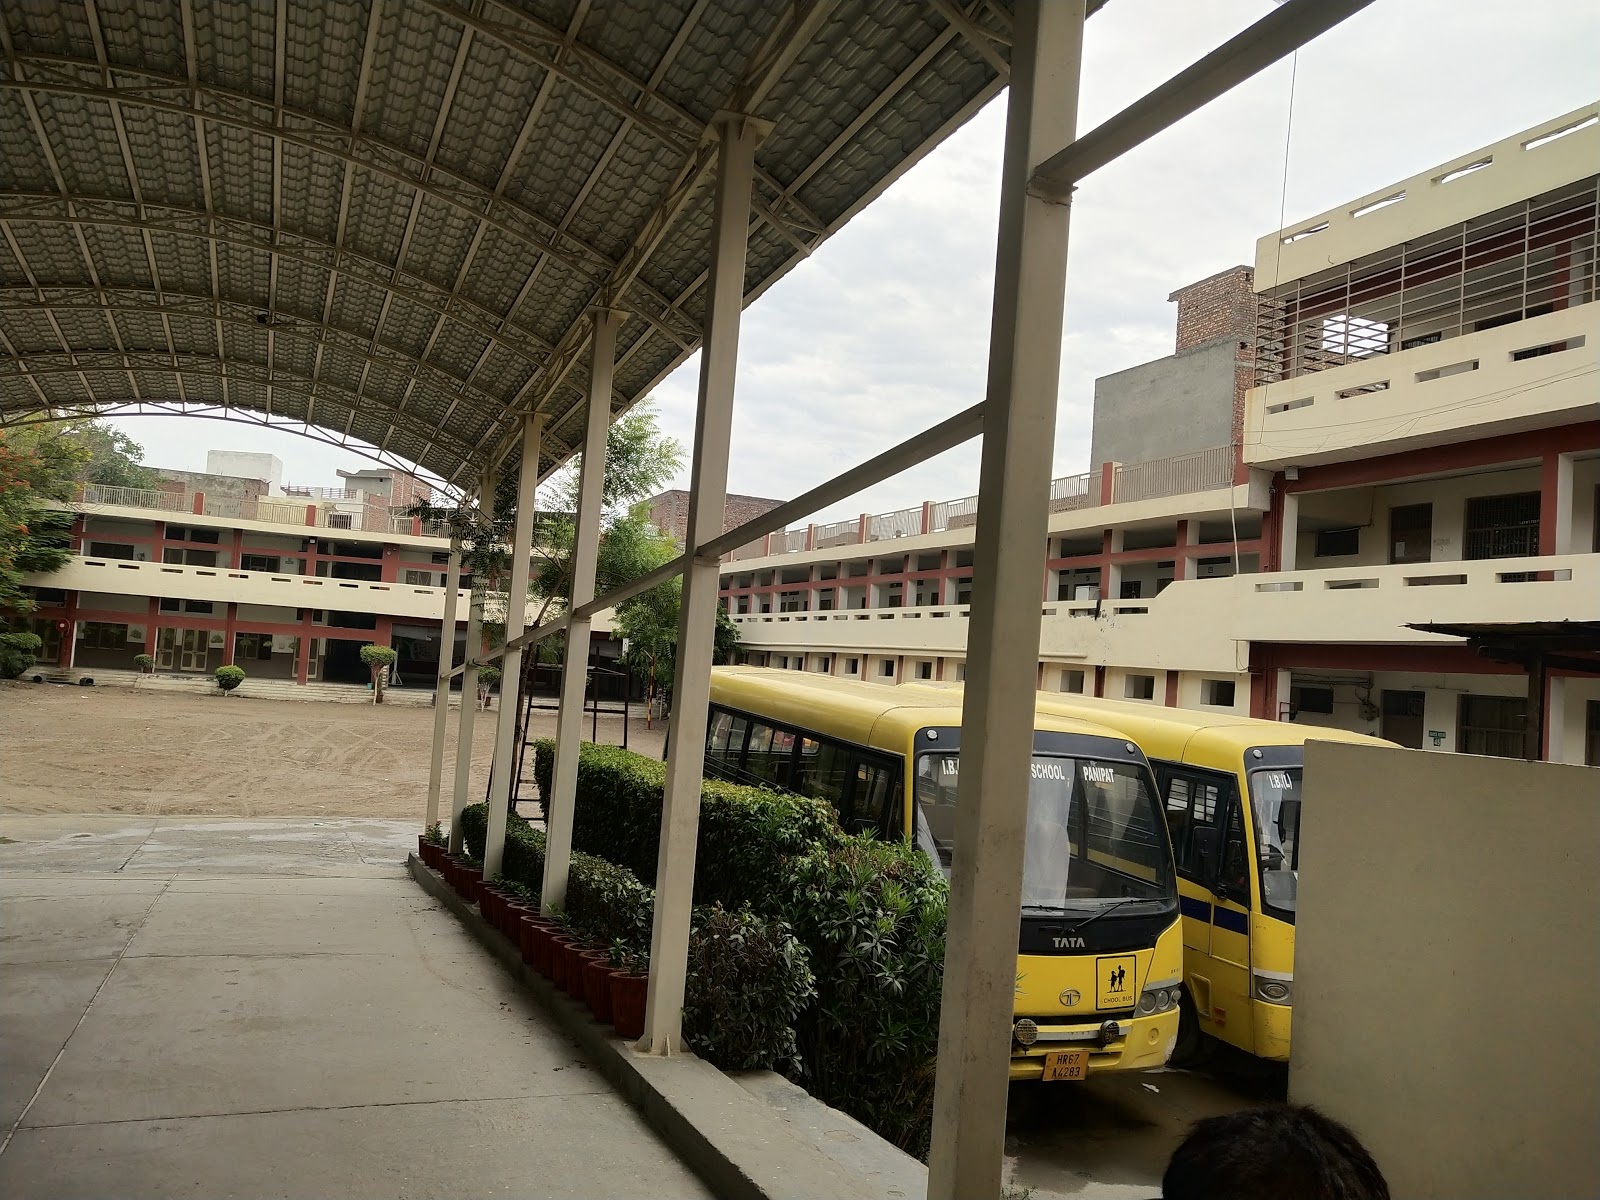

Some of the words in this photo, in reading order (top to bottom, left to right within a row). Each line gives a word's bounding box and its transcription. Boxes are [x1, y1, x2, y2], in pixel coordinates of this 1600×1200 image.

[1031, 763, 1065, 780] SCHOOL
[1083, 766, 1114, 783] PANIPAT
[1052, 937, 1086, 948] TATA
[1056, 1054, 1080, 1065] HR67
[1051, 1066, 1081, 1078] A4283
